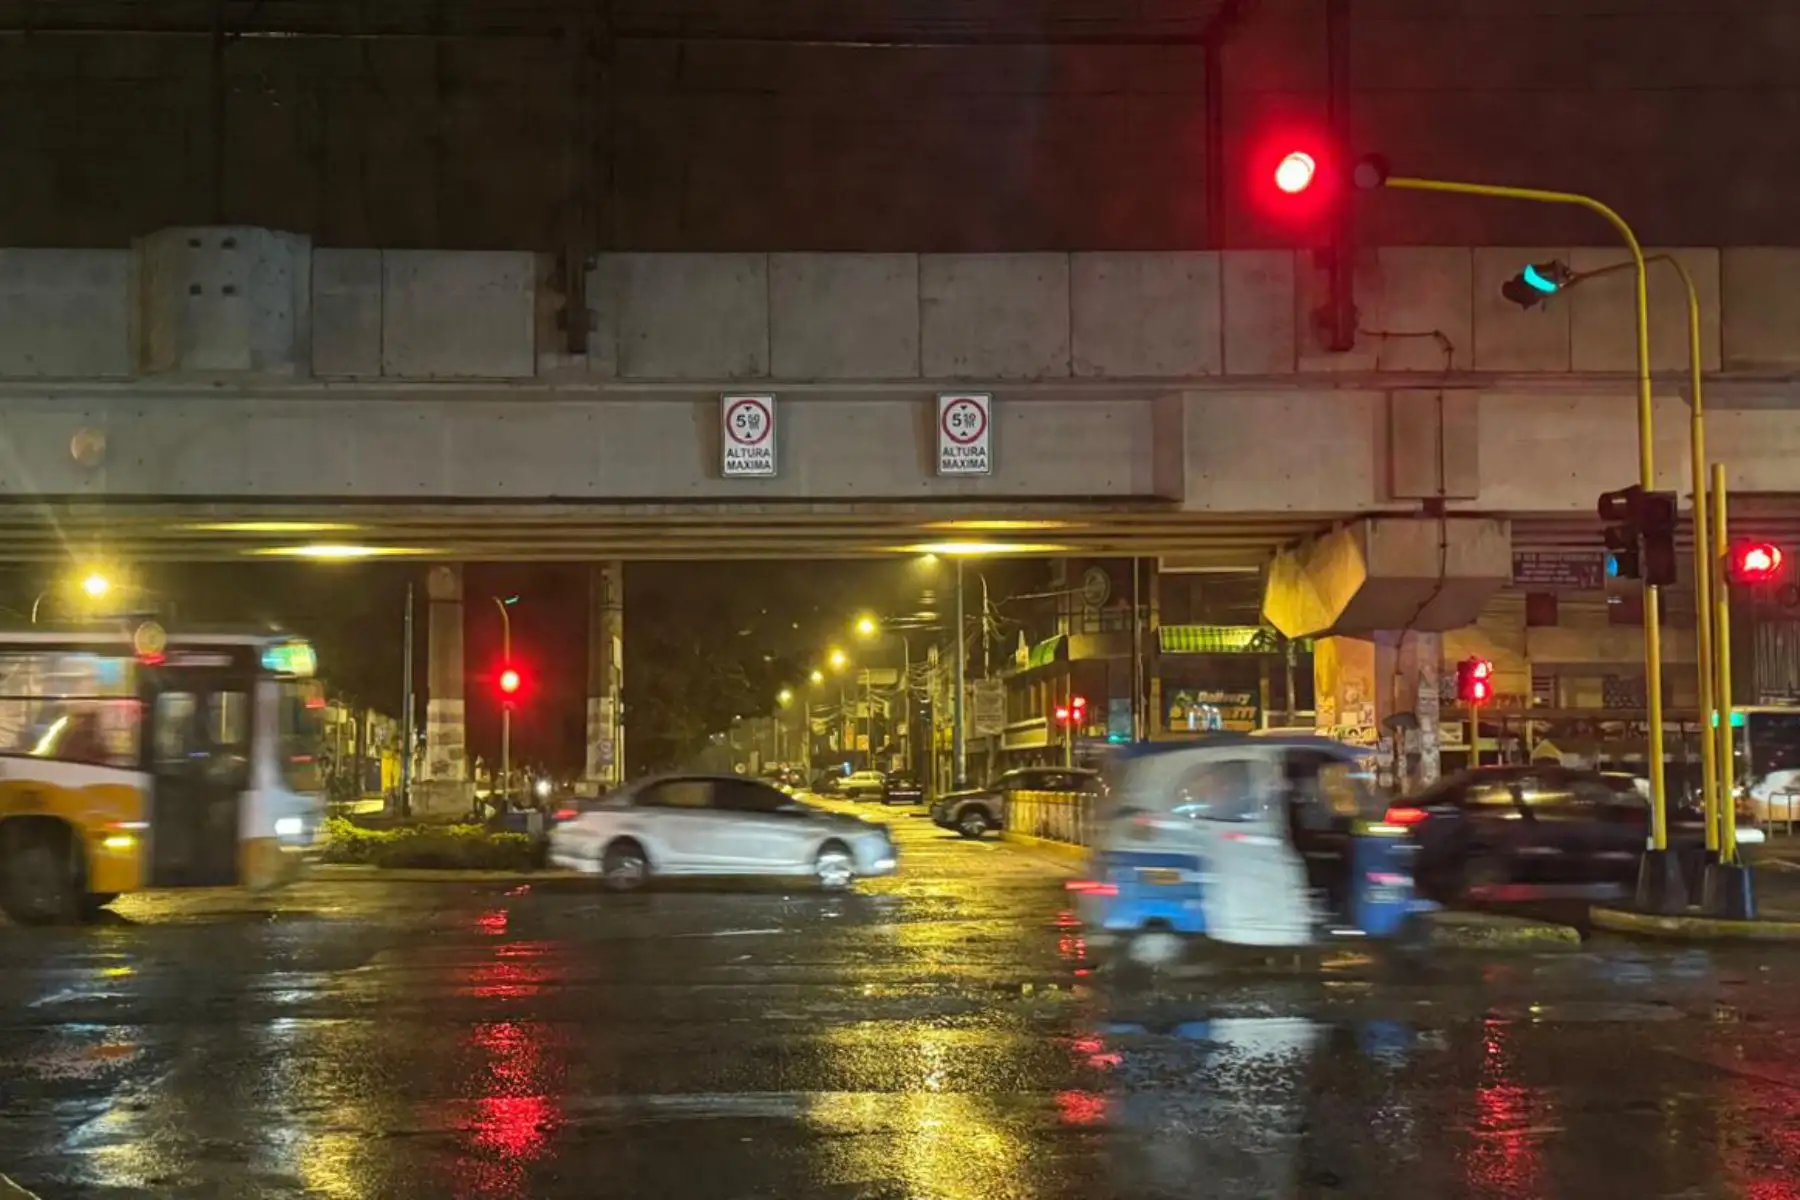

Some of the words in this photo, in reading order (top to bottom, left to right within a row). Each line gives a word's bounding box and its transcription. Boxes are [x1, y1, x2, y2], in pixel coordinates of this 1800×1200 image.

[736, 414, 746, 428] 5
[952, 413, 962, 427] 5
[727, 447, 771, 458] ALTURA
[943, 446, 986, 457] ALTURA
[727, 459, 771, 470] MAXIMA
[943, 458, 986, 469] MAXIMA
